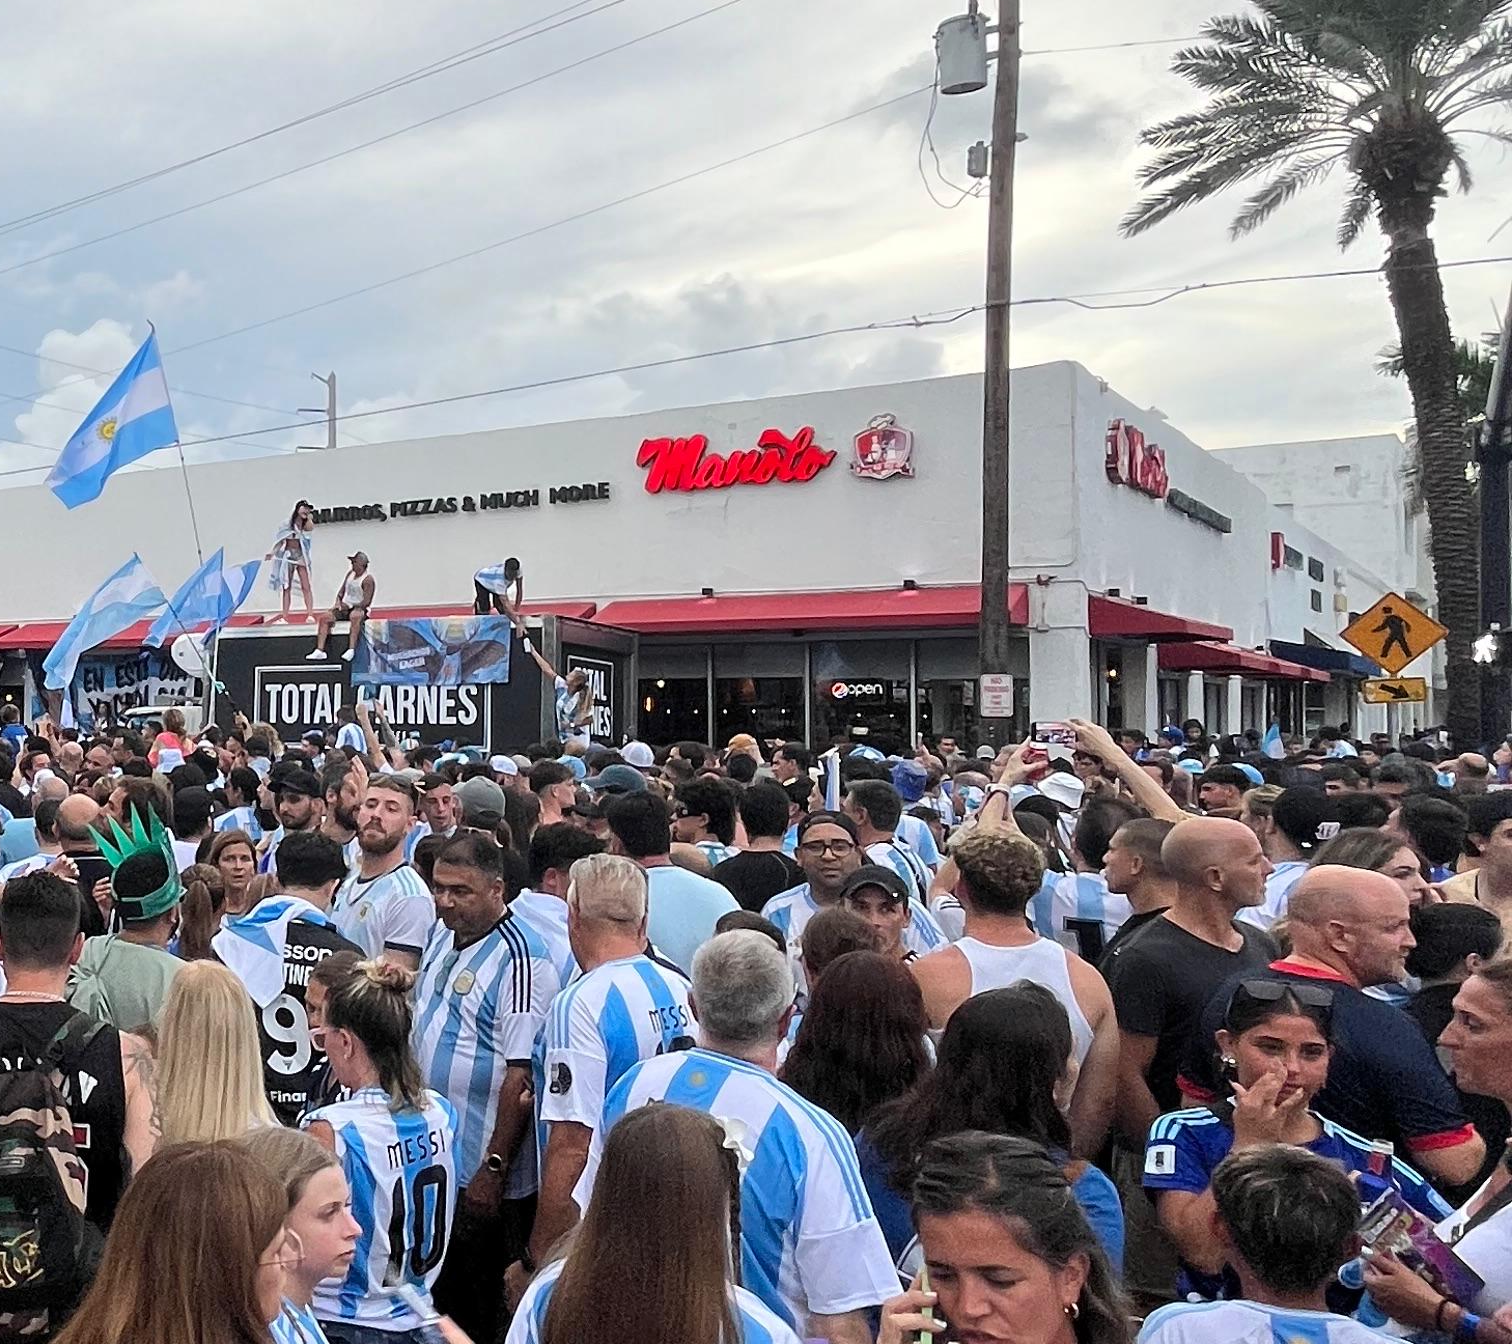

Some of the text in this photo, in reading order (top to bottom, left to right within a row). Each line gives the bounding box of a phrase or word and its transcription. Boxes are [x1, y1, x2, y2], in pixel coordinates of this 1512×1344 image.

[390, 497, 458, 518] PIZZAS
[461, 496, 476, 512] &
[480, 489, 539, 510] MUCH
[549, 482, 611, 504] MORE
[848, 683, 884, 698] open
[262, 993, 312, 1075] 9
[648, 1004, 692, 1034] MESSI
[387, 1128, 446, 1170] MESSI
[382, 1164, 448, 1288] 10
